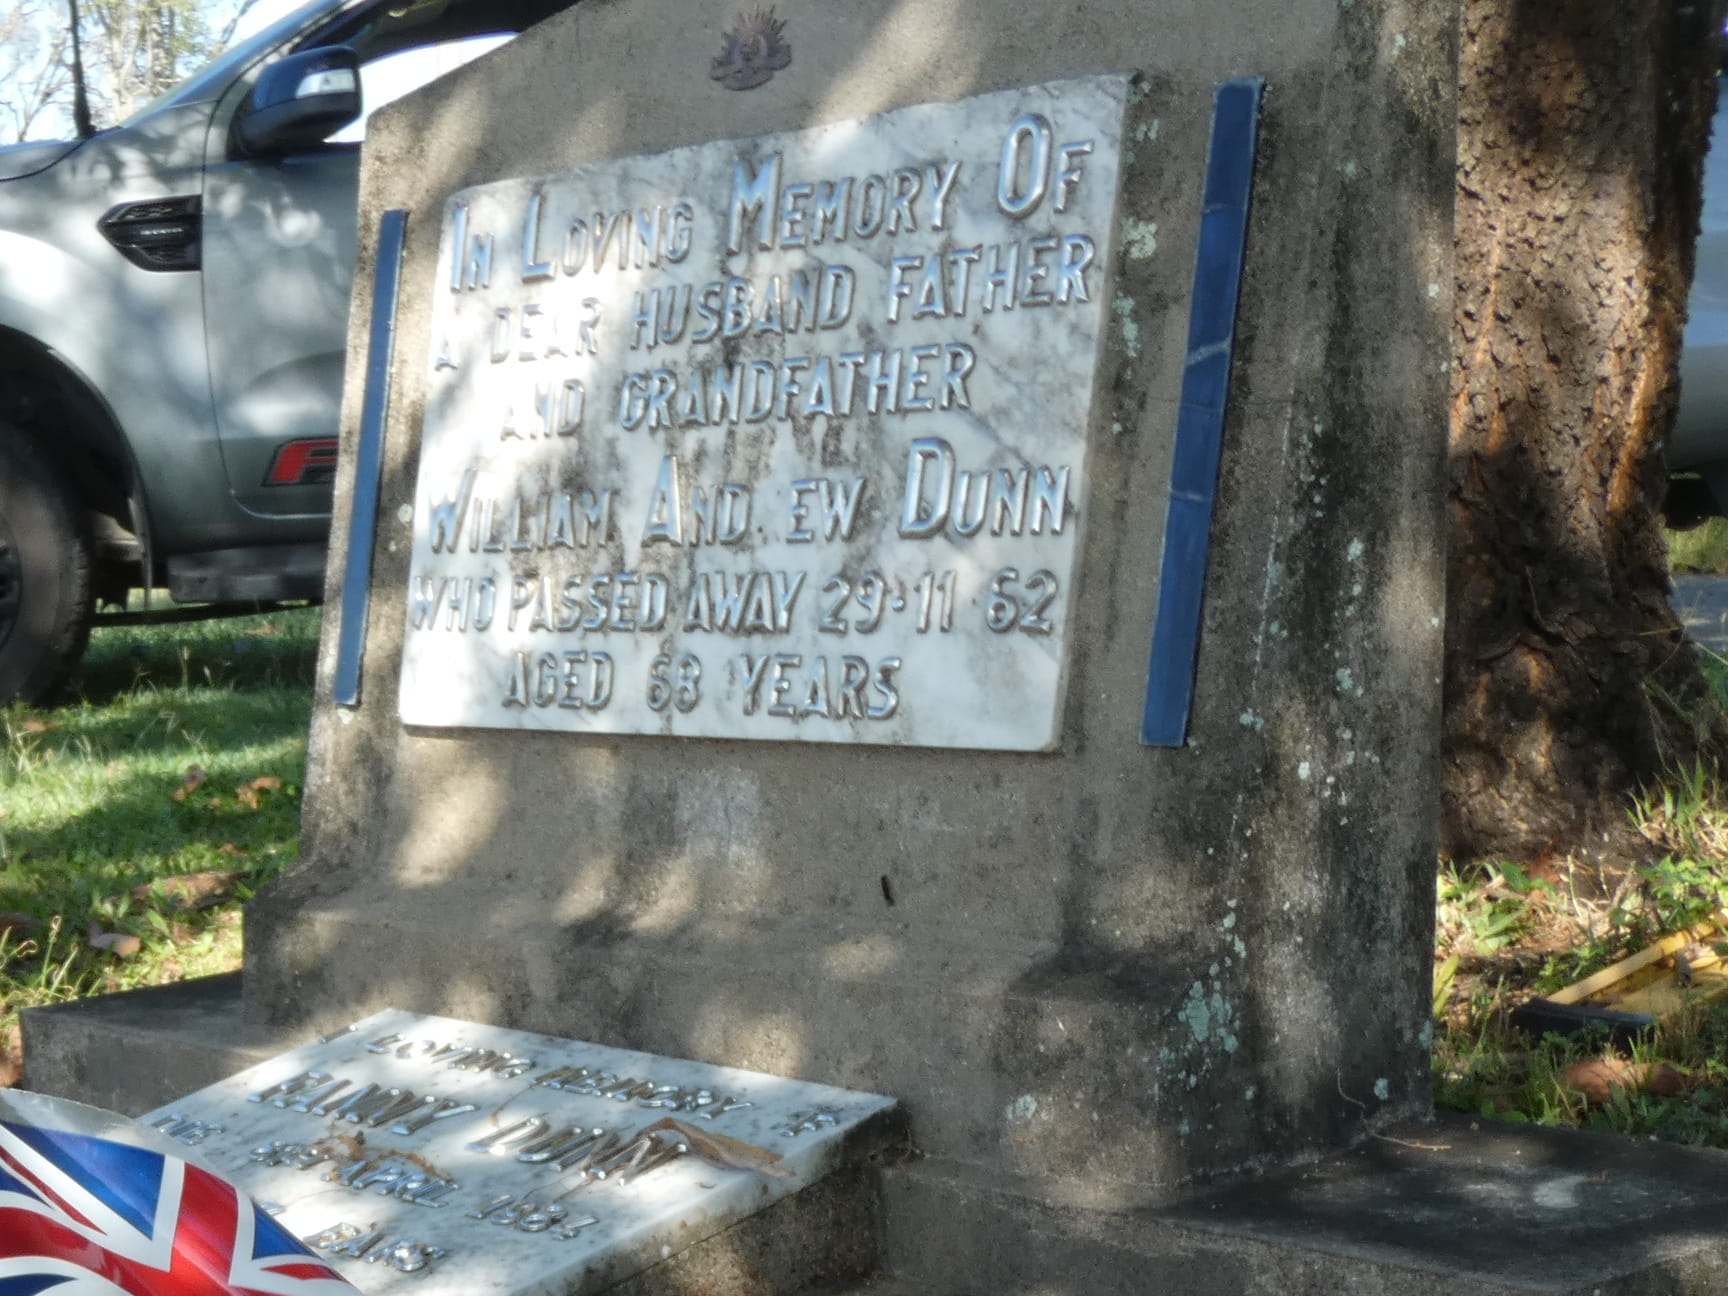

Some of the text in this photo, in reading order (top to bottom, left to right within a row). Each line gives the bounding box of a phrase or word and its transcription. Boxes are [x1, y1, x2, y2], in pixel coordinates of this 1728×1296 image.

[450, 113, 1094, 293] IN LOVING MEMORY OF
[628, 263, 856, 352] HUSBAND
[886, 233, 1096, 325] FATHER
[499, 342, 977, 441] AND GRANDFATHER
[261, 435, 339, 488] F
[429, 468, 618, 554] WILLIAM
[897, 437, 1070, 540] DUNN
[410, 576, 496, 632] WHO
[508, 571, 670, 633] PASSED
[683, 570, 807, 633] AWAY
[501, 651, 903, 720] AGED 68 YEARS
[364, 1033, 537, 1080] LOVING
[463, 1113, 690, 1187] DUNN
